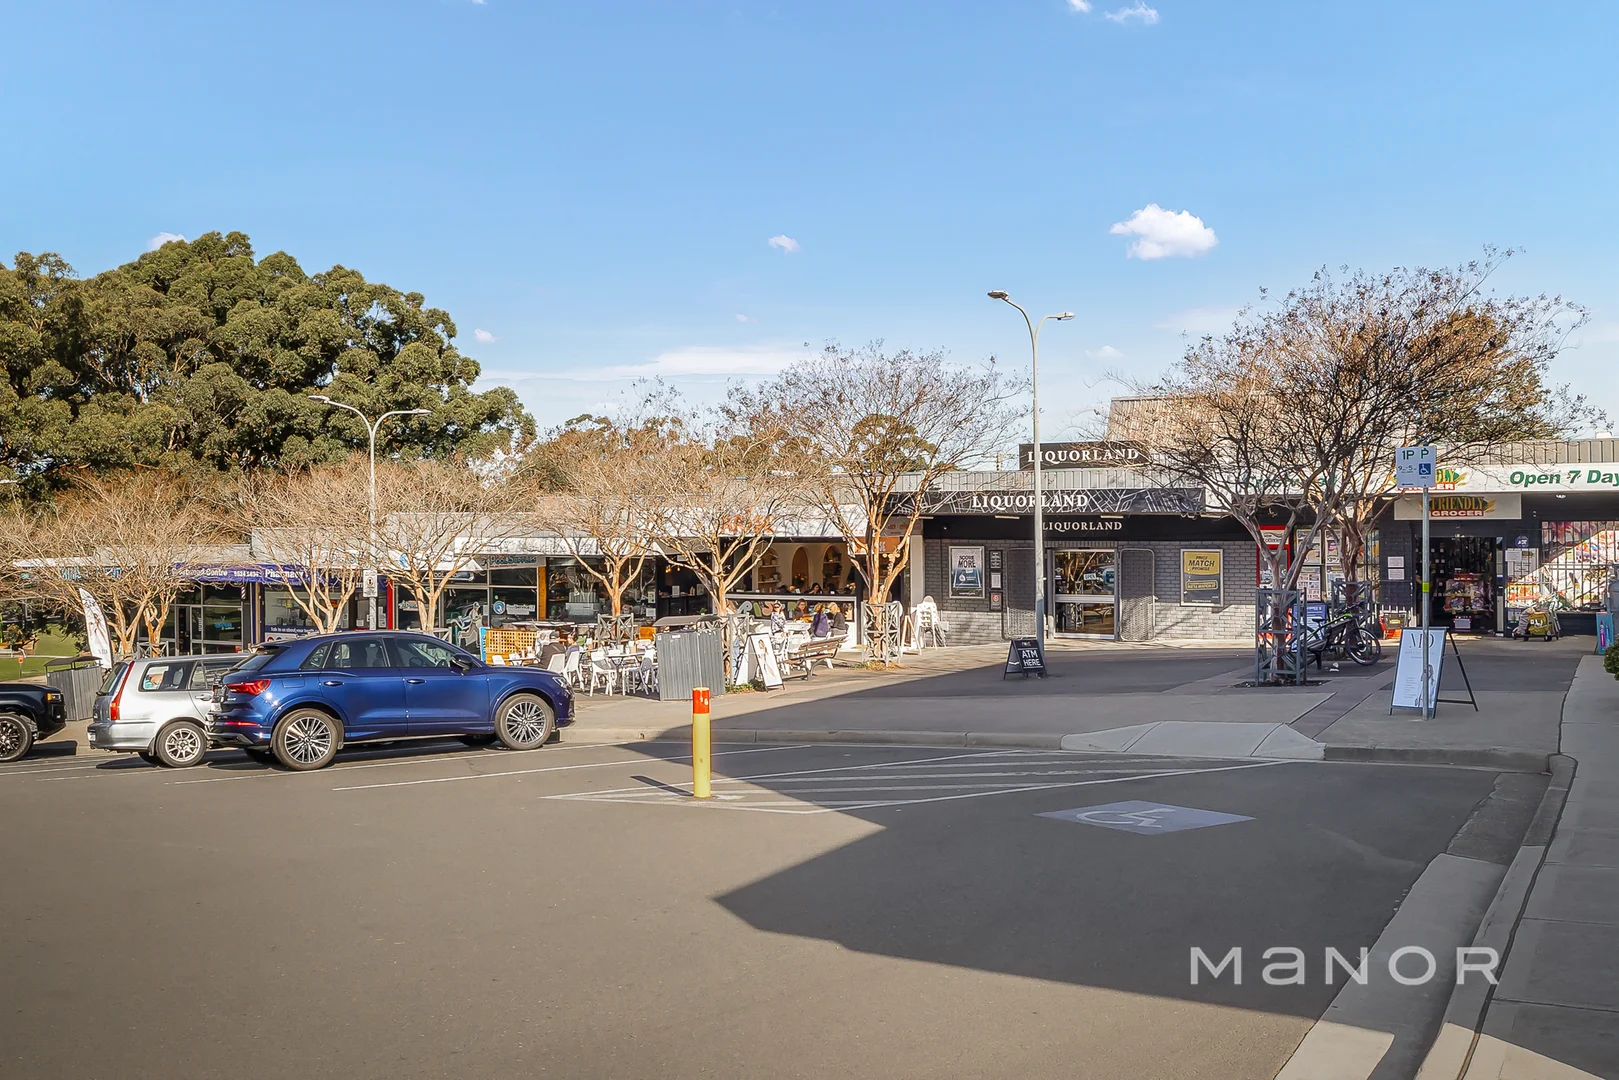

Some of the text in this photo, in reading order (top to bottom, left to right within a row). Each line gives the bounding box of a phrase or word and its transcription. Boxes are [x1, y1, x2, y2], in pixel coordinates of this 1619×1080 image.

[1028, 448, 1139, 464] LIQUORLAND
[1402, 450, 1429, 460] 1P P
[1510, 471, 1561, 487] Open
[1569, 470, 1581, 483] 7
[1431, 497, 1483, 510] FRIENDLY
[1042, 521, 1122, 533] LIQUORLAND
[958, 560, 976, 568] MORE
[1022, 650, 1038, 659] ATM
[1023, 658, 1041, 667] HERE
